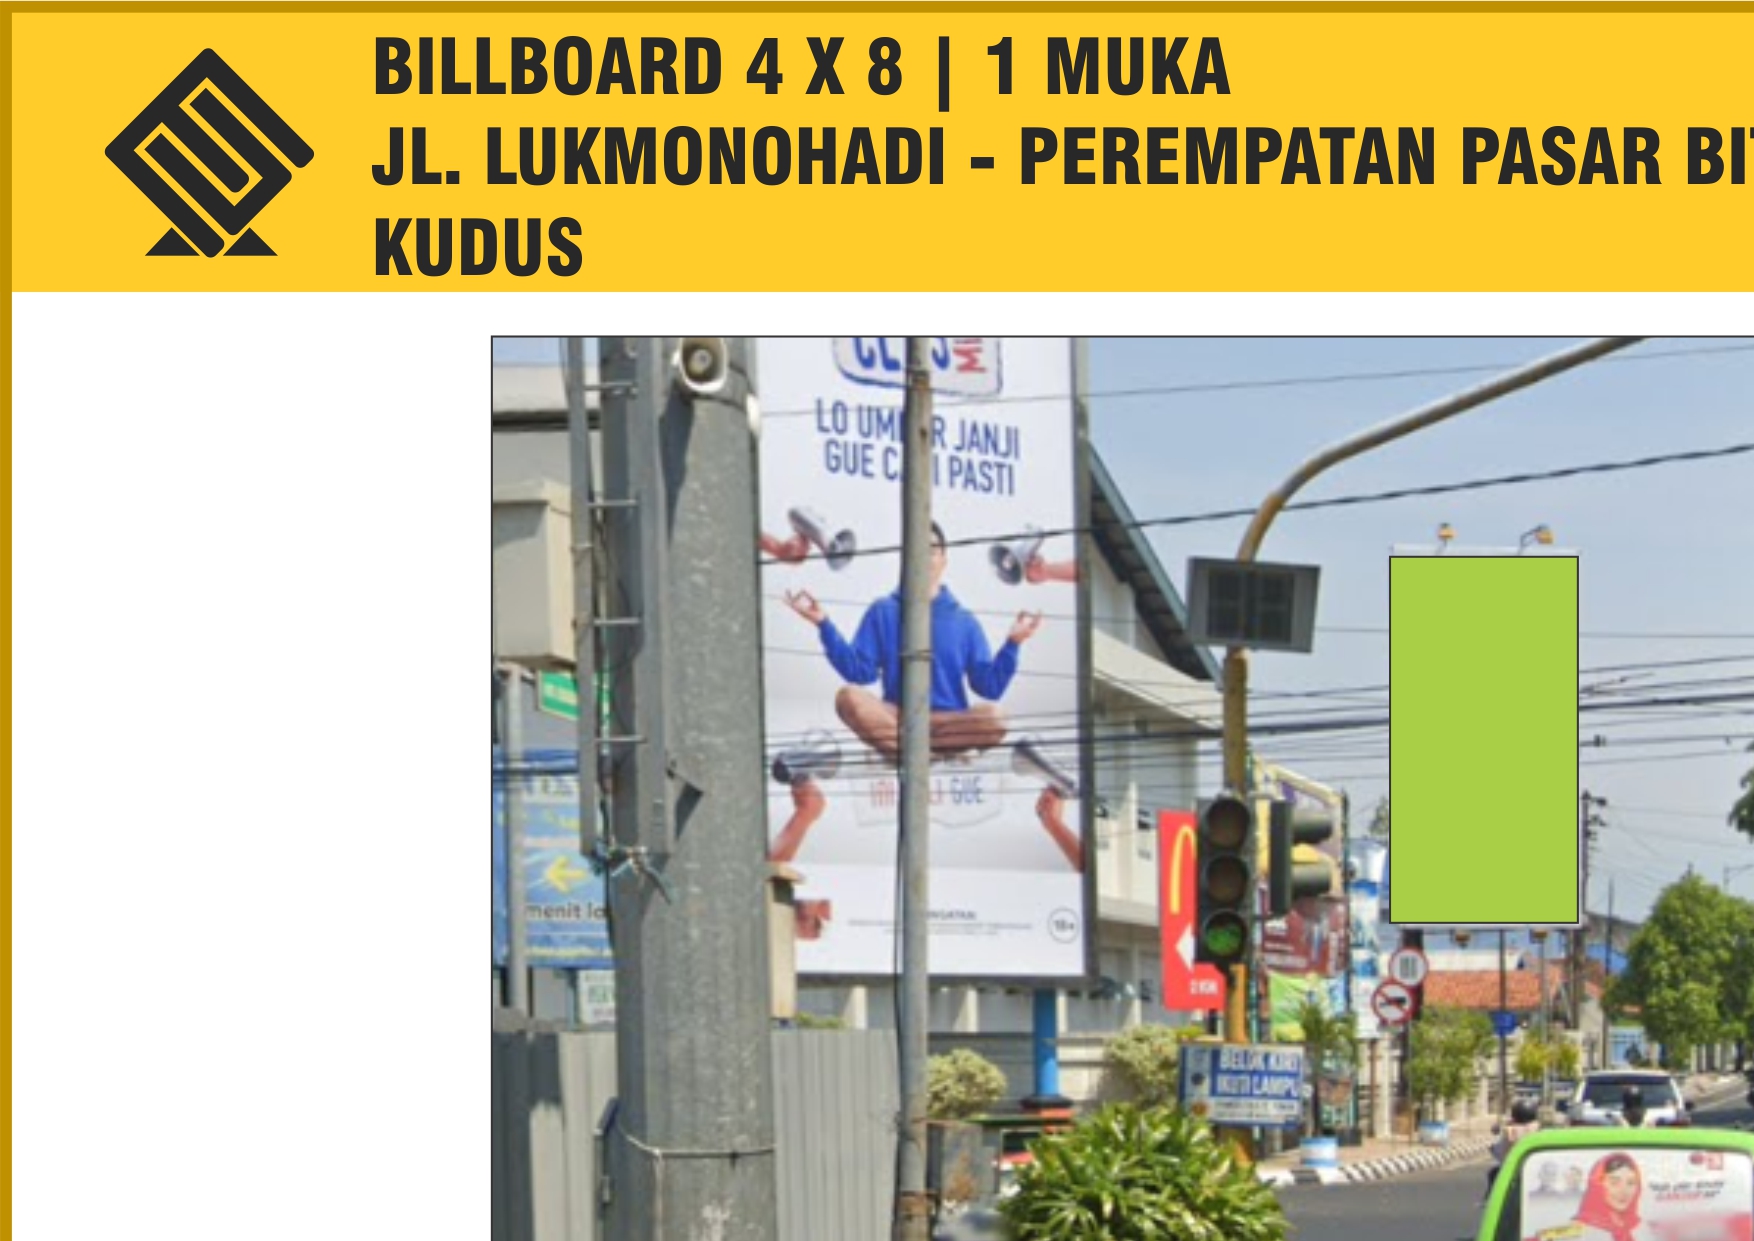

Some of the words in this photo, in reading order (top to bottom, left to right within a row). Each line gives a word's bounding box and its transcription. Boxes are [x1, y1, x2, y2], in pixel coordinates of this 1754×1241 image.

[816, 397, 848, 435] LO
[858, 403, 947, 450] UMR
[953, 419, 1020, 460] JANJI
[825, 439, 875, 479] GUE
[949, 455, 1014, 496] PASTI
